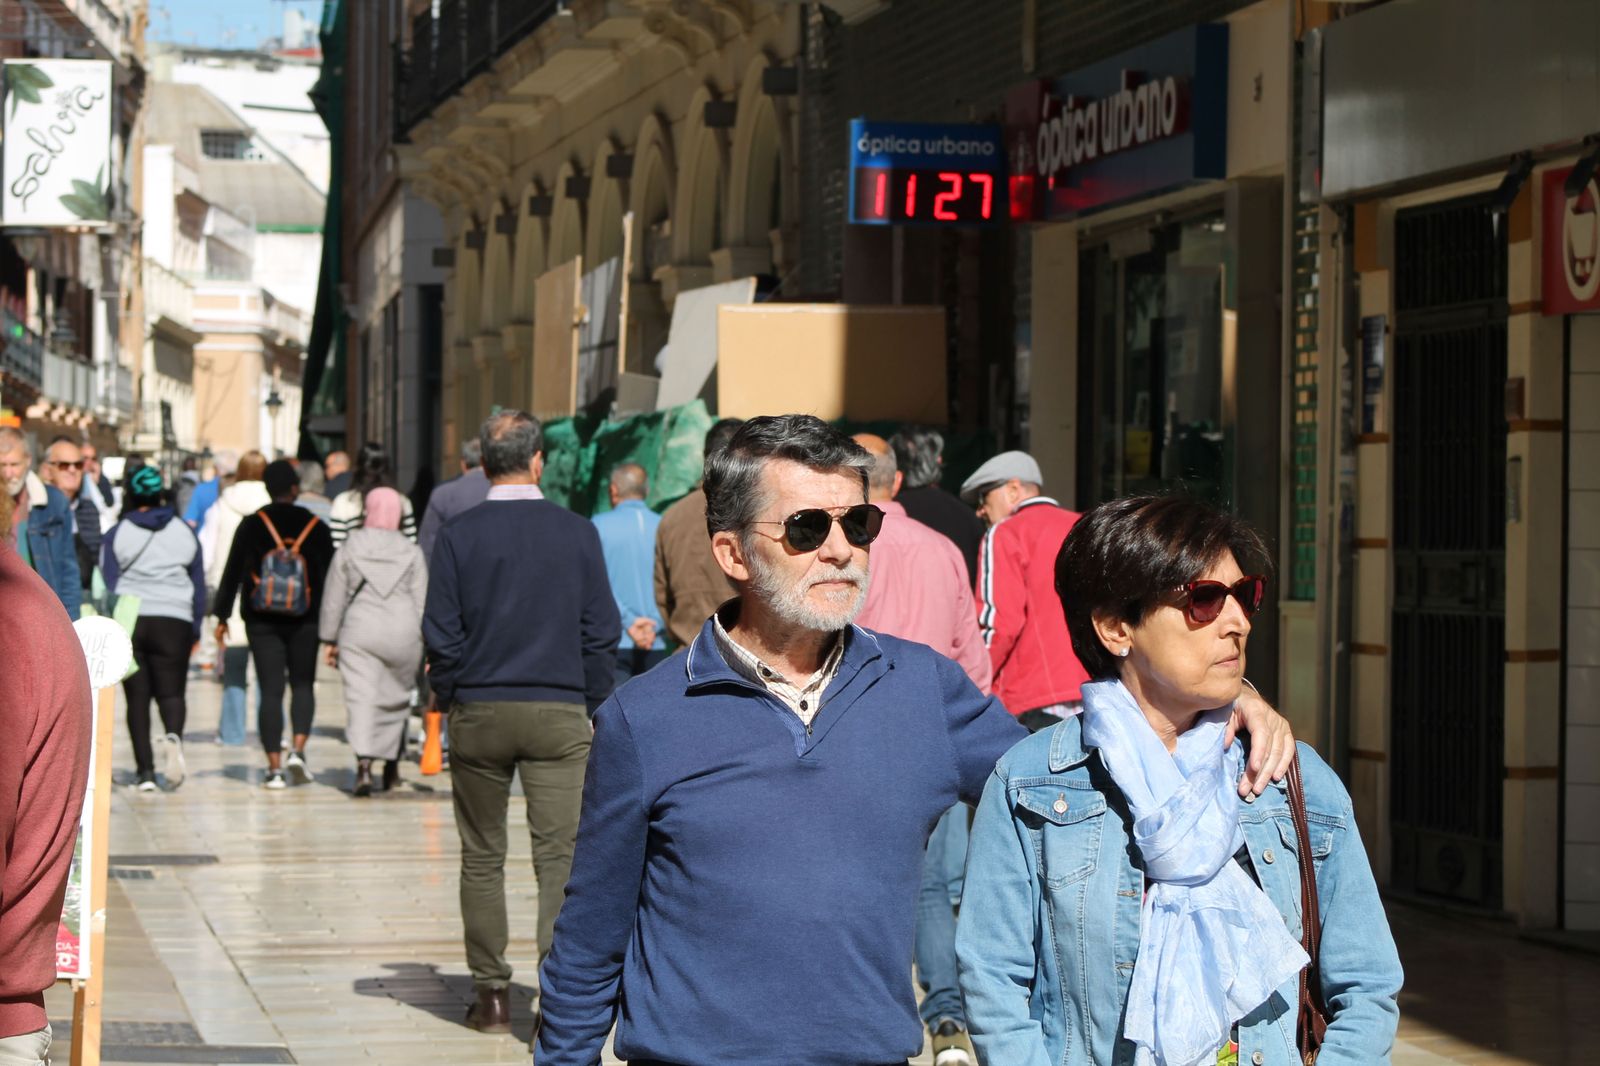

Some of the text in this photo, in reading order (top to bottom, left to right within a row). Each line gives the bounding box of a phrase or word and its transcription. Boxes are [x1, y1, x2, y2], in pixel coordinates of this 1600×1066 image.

[856, 127, 995, 157] óptica urbano
[1038, 68, 1177, 190] óptica urbano
